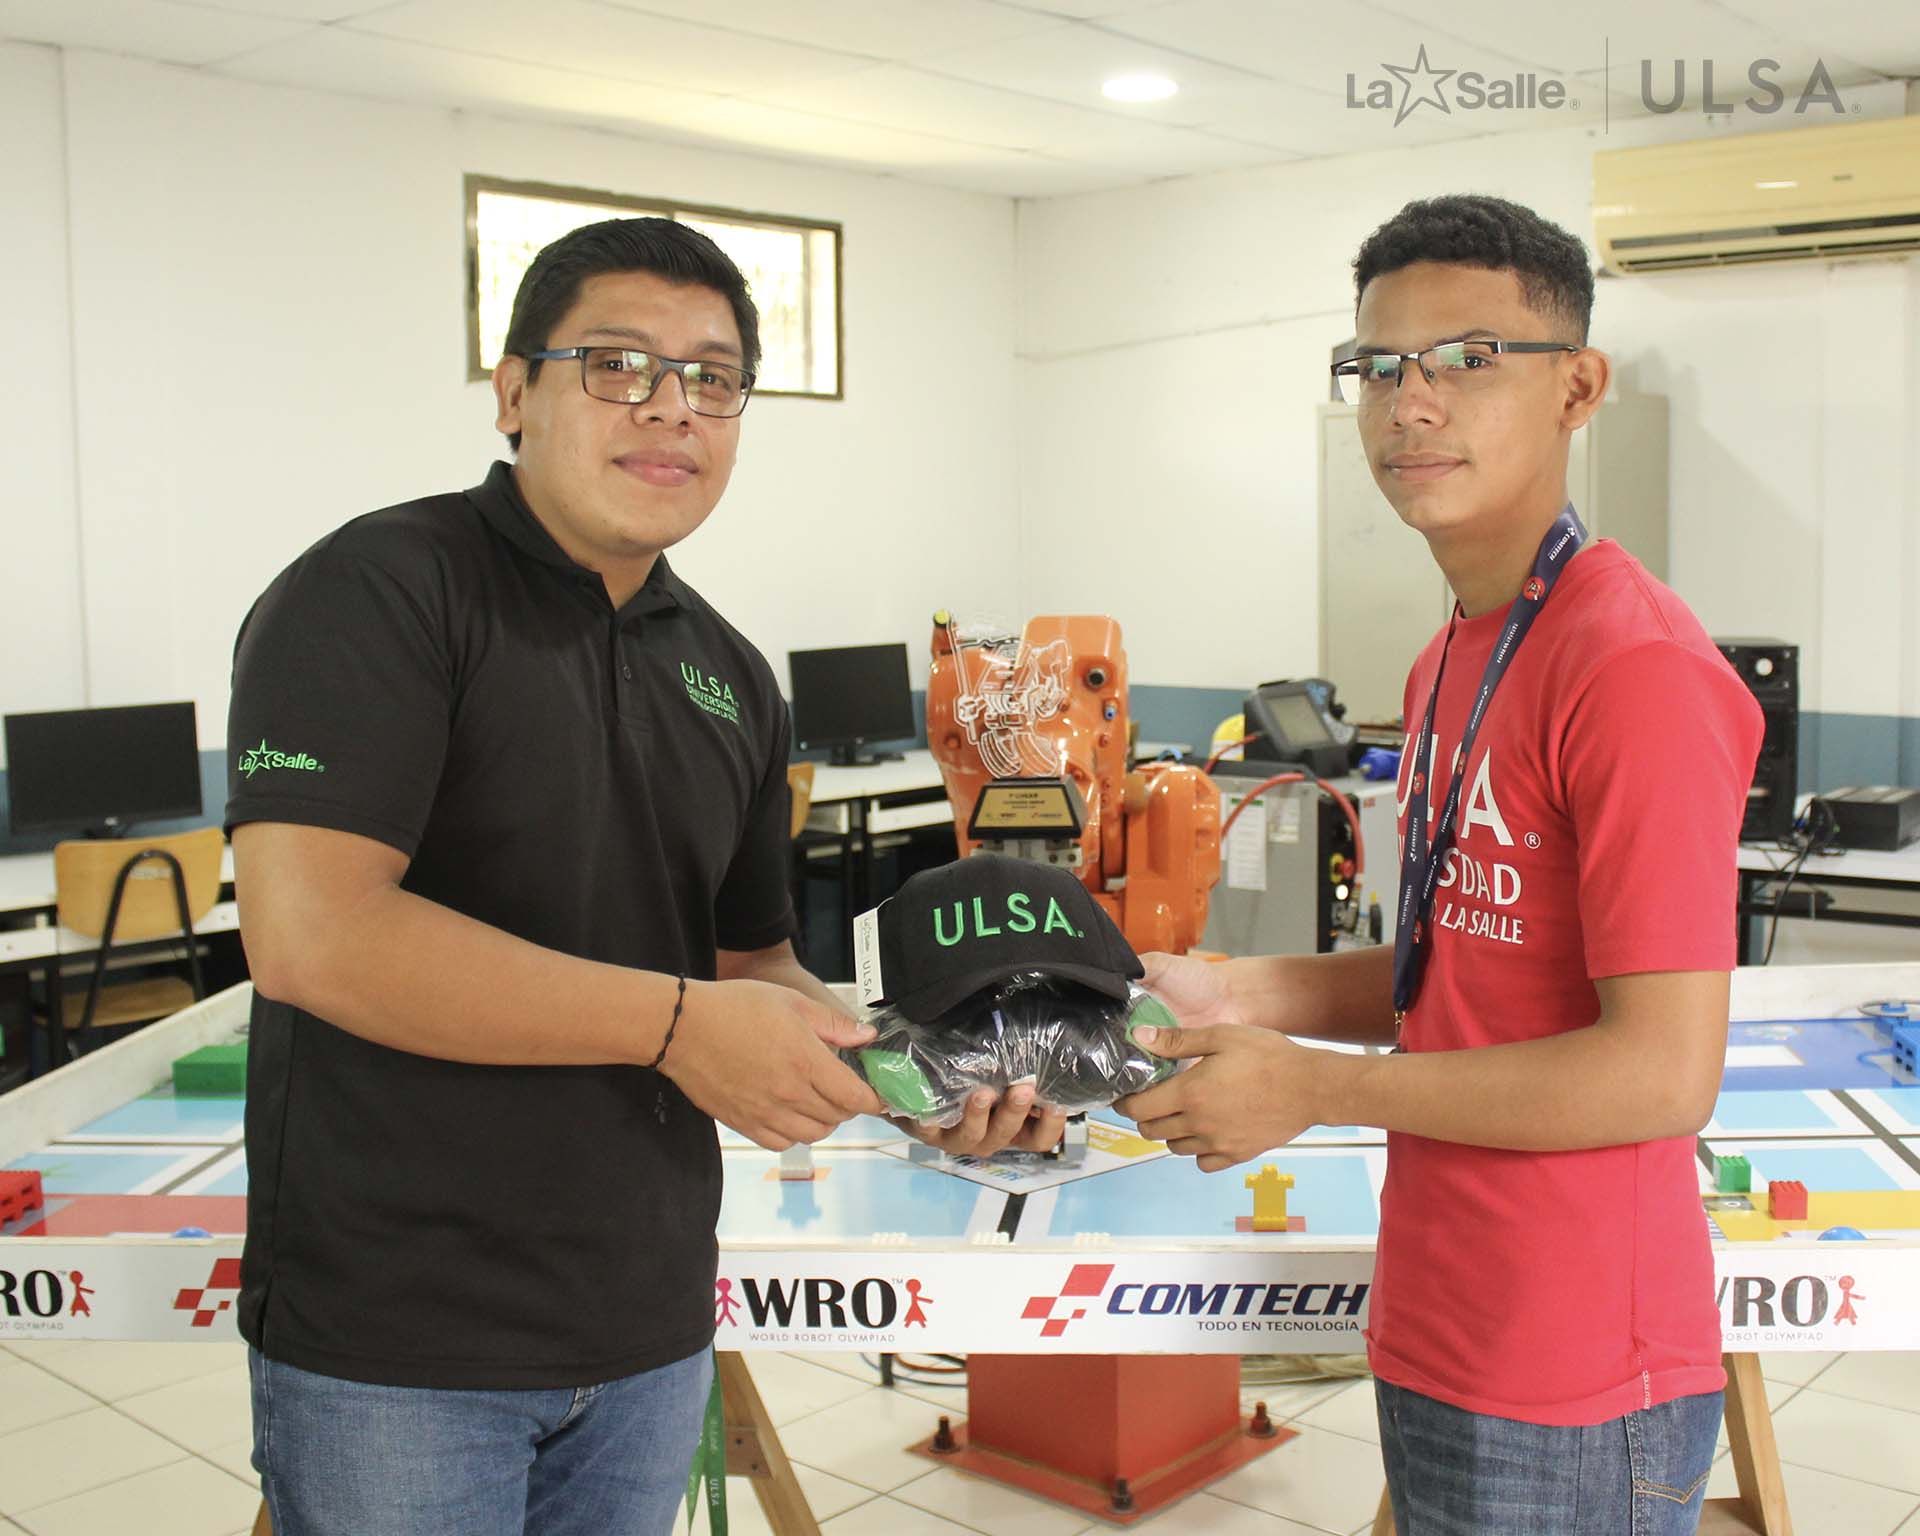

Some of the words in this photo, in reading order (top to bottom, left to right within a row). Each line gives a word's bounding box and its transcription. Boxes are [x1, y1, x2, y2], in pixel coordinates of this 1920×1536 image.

[680, 661, 735, 705] ULSA
[238, 756, 252, 771] La
[271, 752, 318, 771] Salle
[933, 892, 1078, 946] ULSA
[1439, 902, 1467, 933] LA
[1467, 909, 1524, 945] SALLE
[862, 960, 872, 997] ULSA
[0, 1269, 64, 1318] RO
[740, 1277, 898, 1329] WRO
[1105, 1283, 1370, 1316] COMTECH
[1717, 1275, 1829, 1327] RO
[749, 1333, 790, 1342] WORLD
[795, 1333, 832, 1343] ROBOT
[837, 1333, 896, 1343] OLYMPIAD
[1199, 1321, 1238, 1332] TODO
[1242, 1321, 1262, 1332] EN
[1265, 1318, 1360, 1332] TECNOLOGÍA
[1725, 1332, 1758, 1342] OBOT
[1764, 1332, 1824, 1342] OLYMPIAD
[709, 1478, 720, 1507] ULSA
